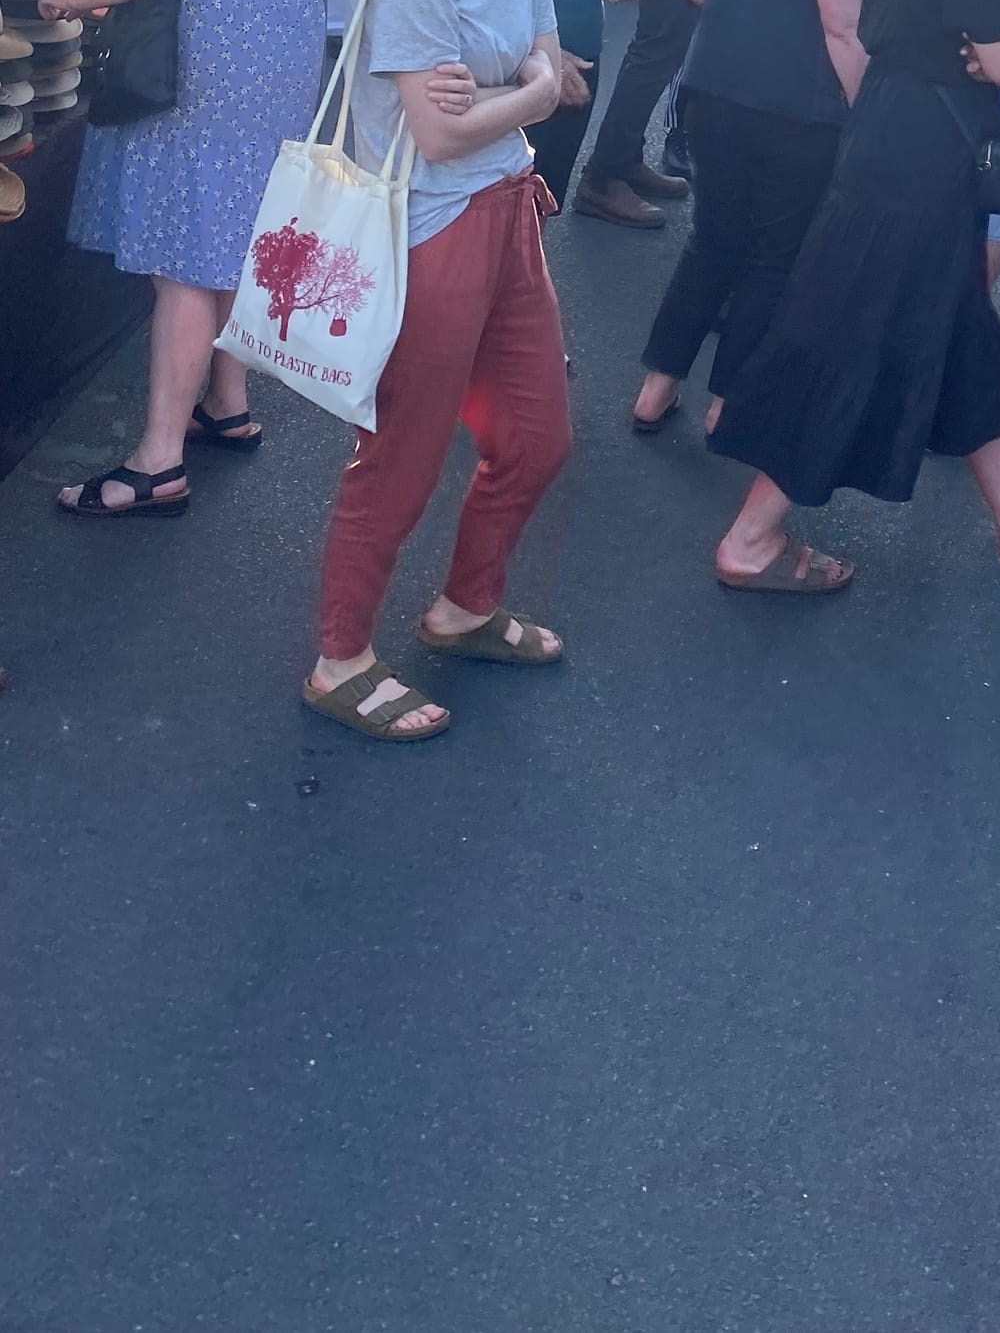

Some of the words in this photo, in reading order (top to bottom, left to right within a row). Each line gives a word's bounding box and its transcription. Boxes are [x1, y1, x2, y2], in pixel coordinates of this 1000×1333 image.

[240, 329, 255, 349] NO
[257, 340, 272, 359] TO
[274, 349, 318, 380] PLASTIC
[321, 367, 353, 387] BAGS
